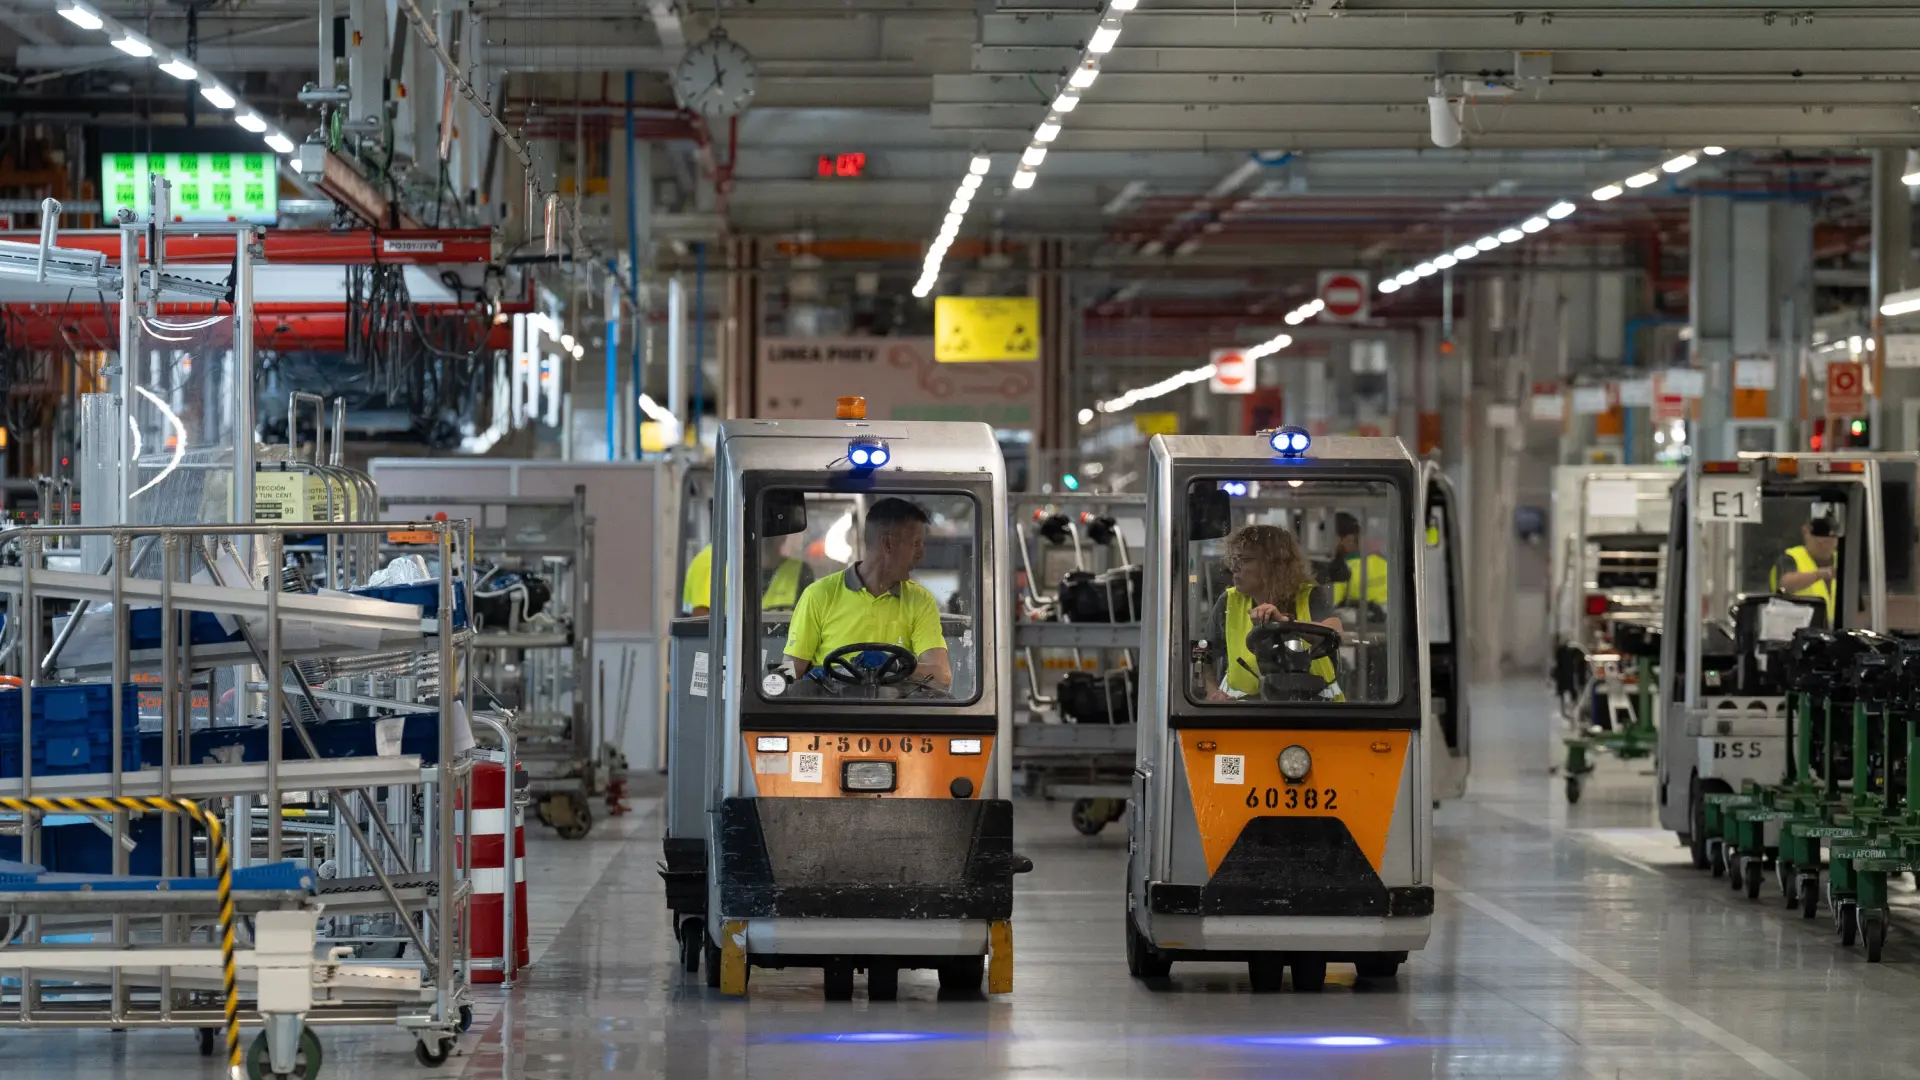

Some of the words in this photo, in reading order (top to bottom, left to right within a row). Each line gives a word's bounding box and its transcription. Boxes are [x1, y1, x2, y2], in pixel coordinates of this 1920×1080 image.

[1712, 491, 1749, 518] E1
[807, 735, 934, 753] J-50065
[1713, 742, 1762, 759] BSS
[1245, 787, 1338, 810] 60382
